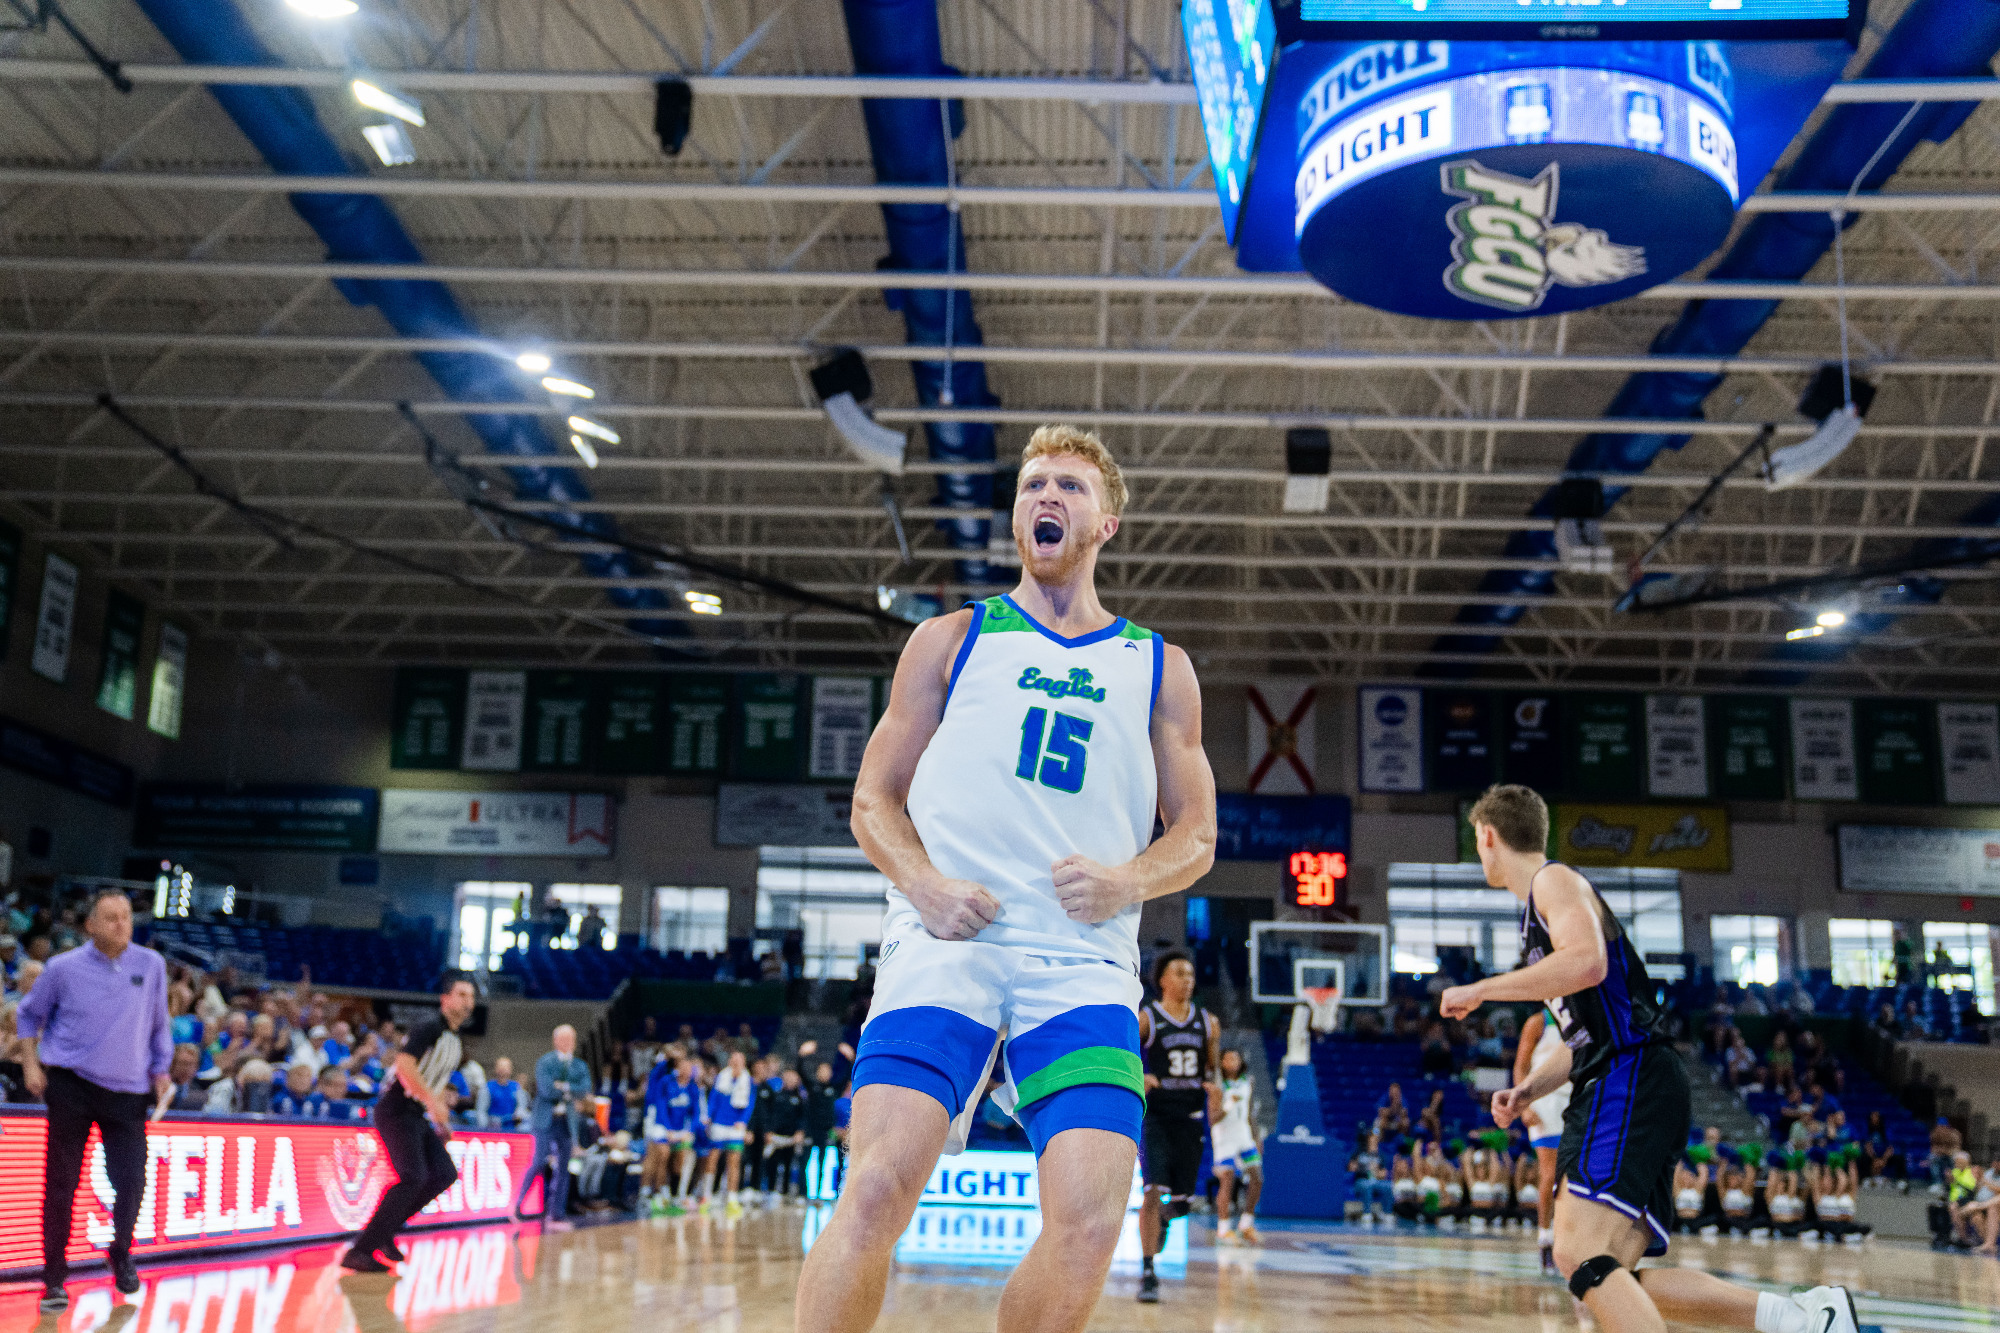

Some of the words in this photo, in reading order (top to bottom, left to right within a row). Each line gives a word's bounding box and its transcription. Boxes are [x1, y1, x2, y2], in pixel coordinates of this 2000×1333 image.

[1326, 104, 1438, 182] LIGHT
[1440, 158, 1560, 312] FGCU
[1017, 667, 1107, 703] Eagles
[1015, 706, 1094, 795] 15
[1297, 872, 1336, 907] 30
[1168, 1049, 1198, 1077] 32
[421, 1138, 512, 1215] TOIS
